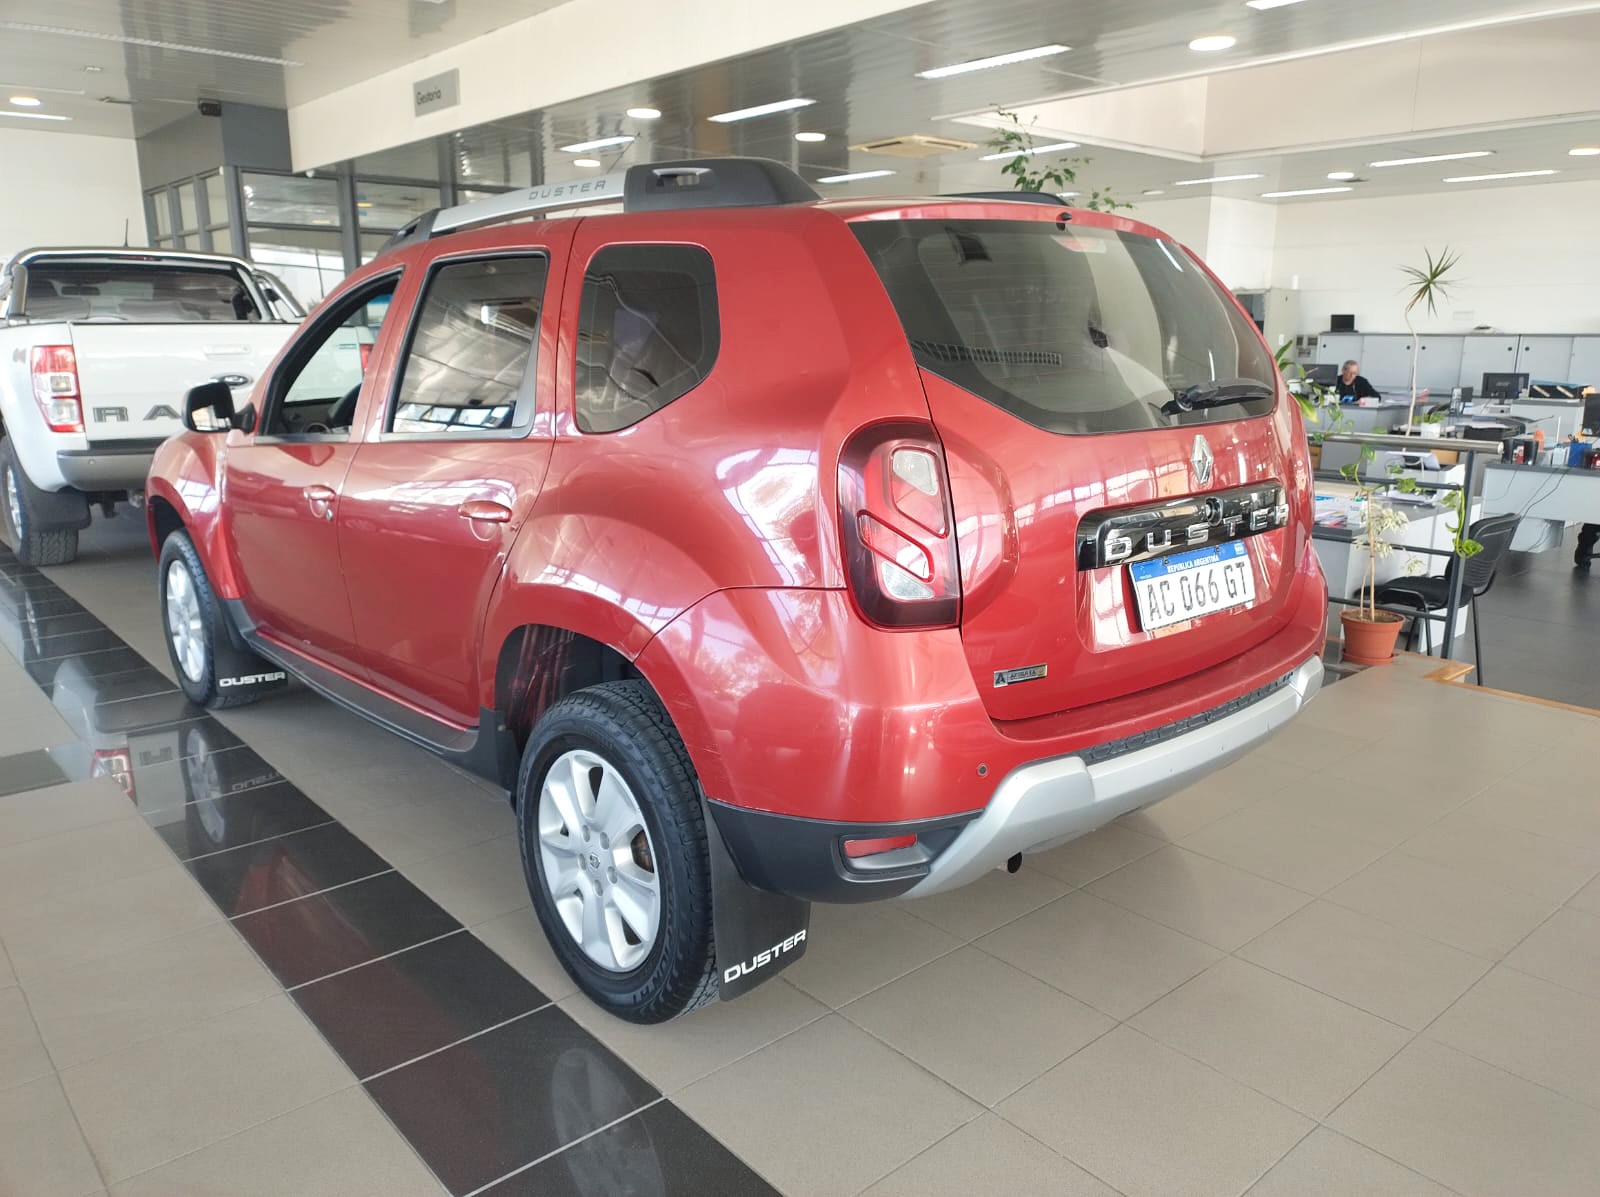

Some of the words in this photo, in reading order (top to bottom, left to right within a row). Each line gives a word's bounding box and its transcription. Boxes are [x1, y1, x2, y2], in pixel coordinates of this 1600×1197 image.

[528, 180, 607, 201] DUSTER
[1104, 503, 1289, 562] DUSTER
[1147, 580, 1175, 621] AC
[1180, 569, 1219, 611] 066
[1224, 561, 1246, 598] GT
[219, 671, 286, 687] DUSTER
[724, 929, 806, 983] DUSTER
